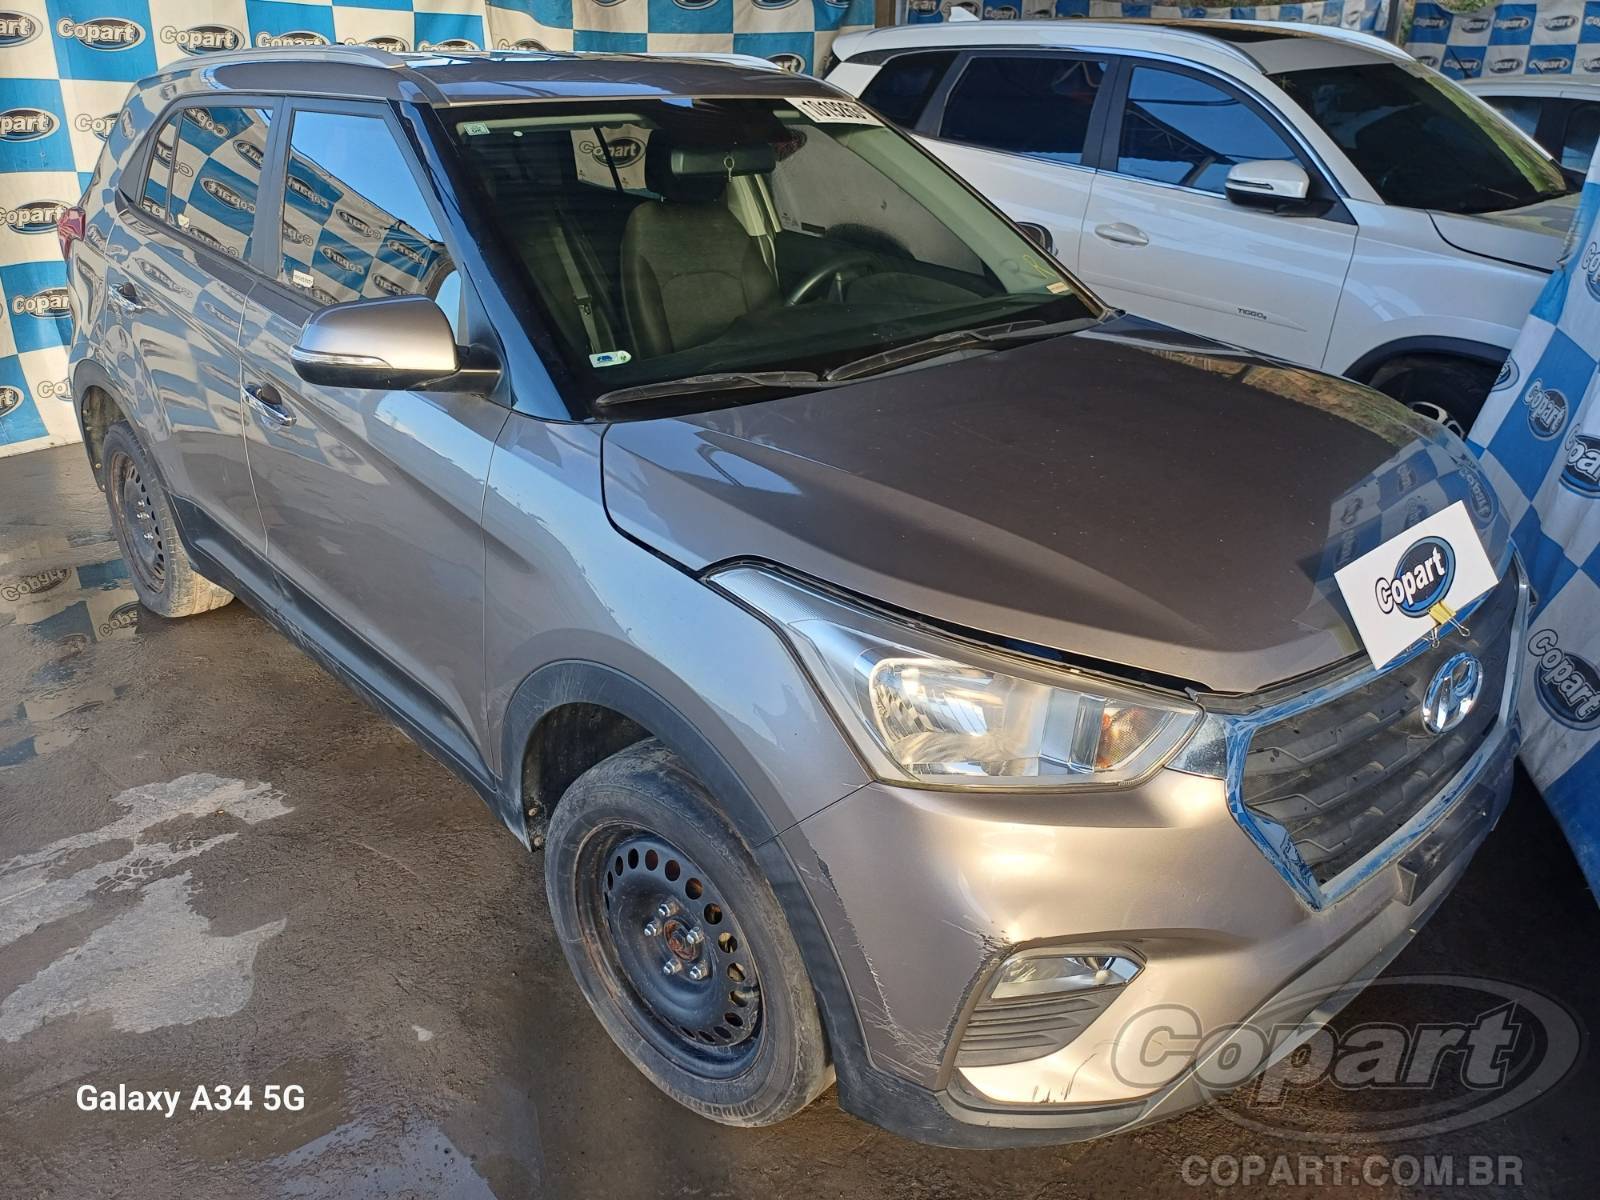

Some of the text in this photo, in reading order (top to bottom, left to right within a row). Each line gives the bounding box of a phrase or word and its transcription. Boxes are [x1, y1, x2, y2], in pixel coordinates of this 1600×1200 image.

[57, 17, 137, 44] Copart
[160, 26, 236, 49] Copart
[1524, 379, 1567, 433] Copart
[1375, 547, 1446, 614] Copart
[1528, 629, 1600, 719] Copart
